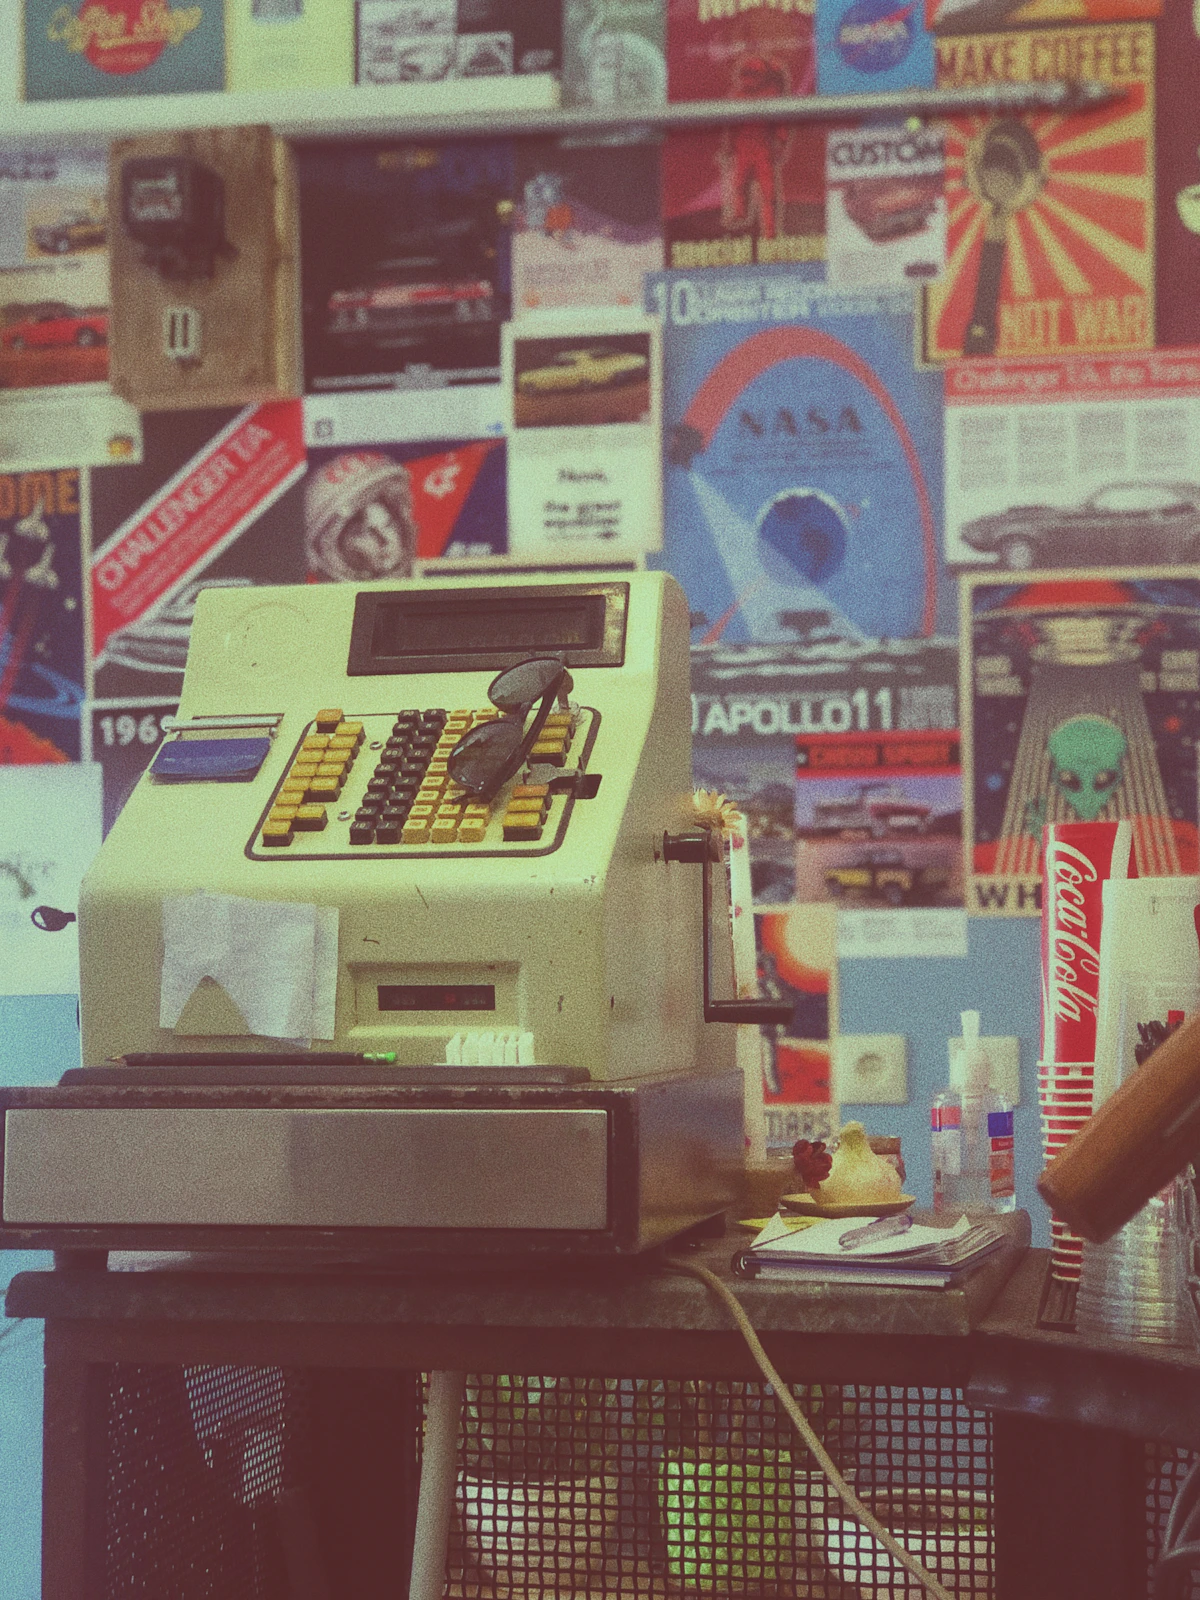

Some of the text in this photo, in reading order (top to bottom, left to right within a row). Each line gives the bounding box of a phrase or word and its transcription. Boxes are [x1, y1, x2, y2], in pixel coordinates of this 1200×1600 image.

[936, 32, 1148, 83] MAKE COFFEE
[1001, 296, 1147, 346] NOT WAR
[738, 404, 867, 437] NASA
[96, 452, 239, 592] CHALLENGER
